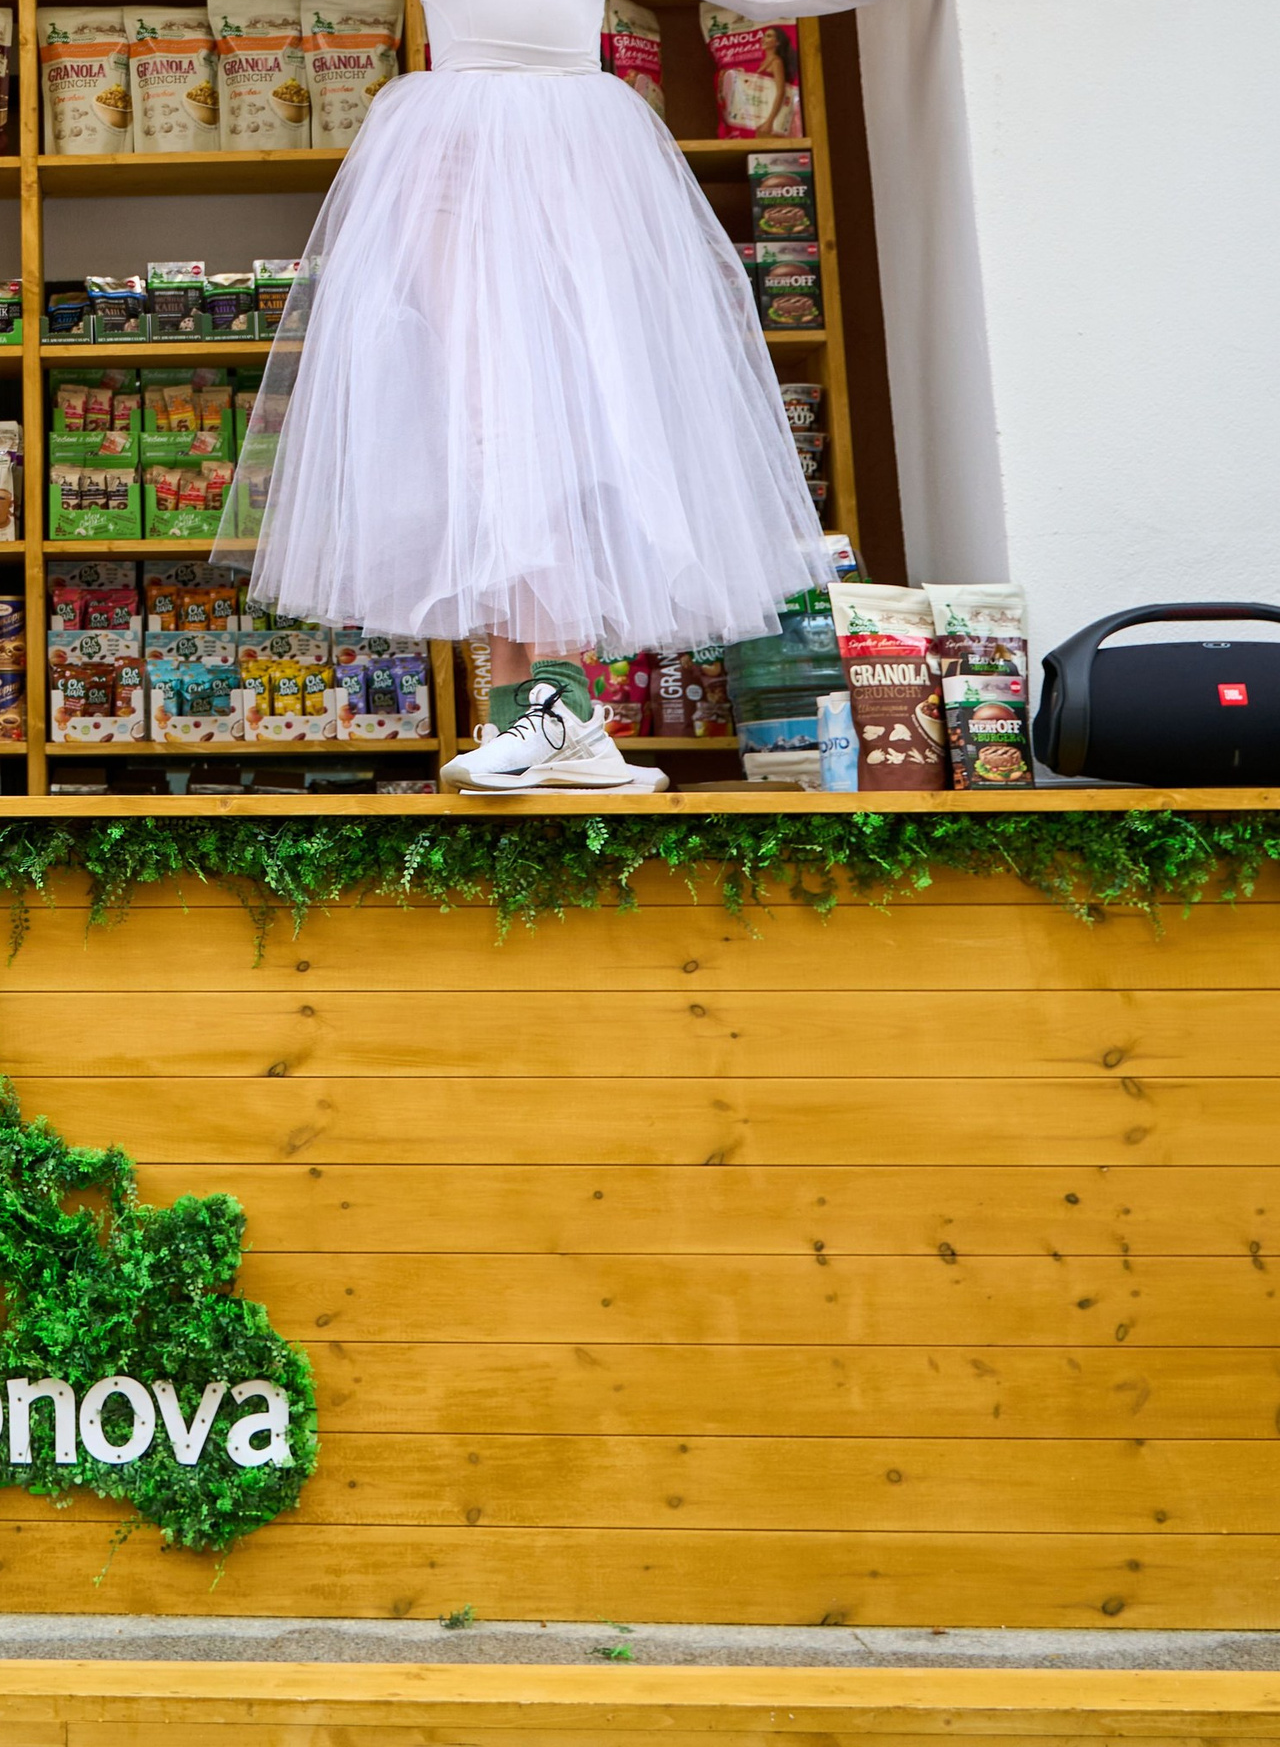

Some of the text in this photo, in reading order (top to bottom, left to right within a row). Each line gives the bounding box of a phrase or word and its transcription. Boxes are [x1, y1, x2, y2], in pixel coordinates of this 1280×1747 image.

[614, 36, 659, 52] GRANOLA
[137, 60, 196, 78] GRANOLA
[224, 57, 282, 76] GRANOLA
[313, 55, 374, 73] GRANOLA
[48, 64, 106, 82] GRANOLA
[226, 73, 275, 86] CRUNCHY
[314, 71, 367, 84] CRUNCHY
[49, 79, 98, 92] CRUNCHY
[139, 75, 189, 88] CRUNCHY
[260, 301, 283, 309] КАШ
[786, 413, 814, 424] CUP
[850, 664, 930, 686] GRANOLA
[854, 686, 921, 700] CRUNCHY
